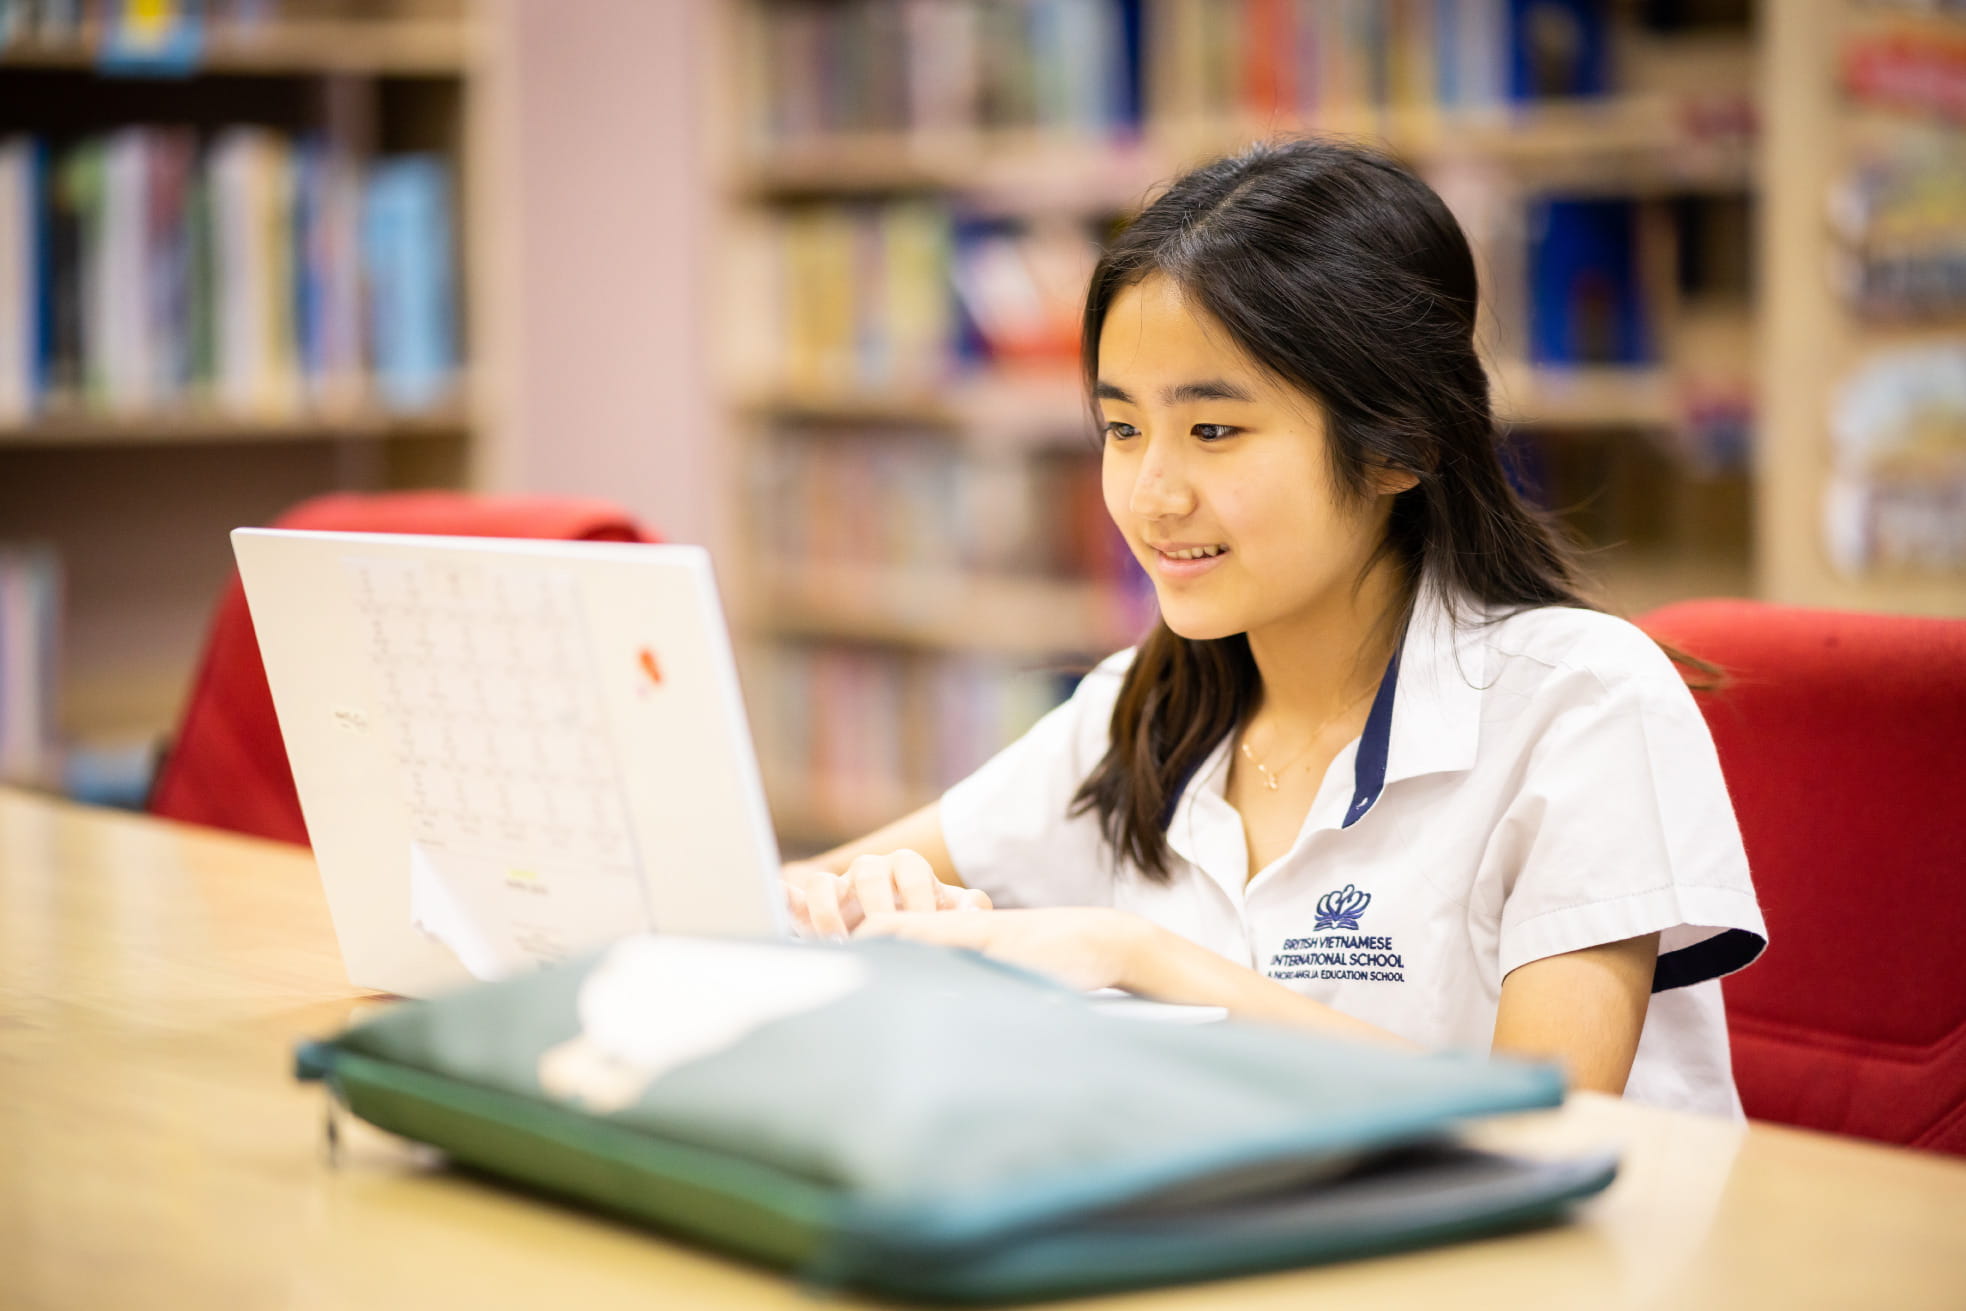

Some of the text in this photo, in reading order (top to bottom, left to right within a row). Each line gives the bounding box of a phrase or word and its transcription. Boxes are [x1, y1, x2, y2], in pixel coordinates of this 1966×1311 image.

[1283, 936, 1393, 950] BRITISH VIETNAMESE
[1271, 953, 1405, 968] INTERNATIONAL SCHOOL
[1321, 970, 1368, 981] EDUCATION
[1370, 971, 1405, 982] SCHOOL
